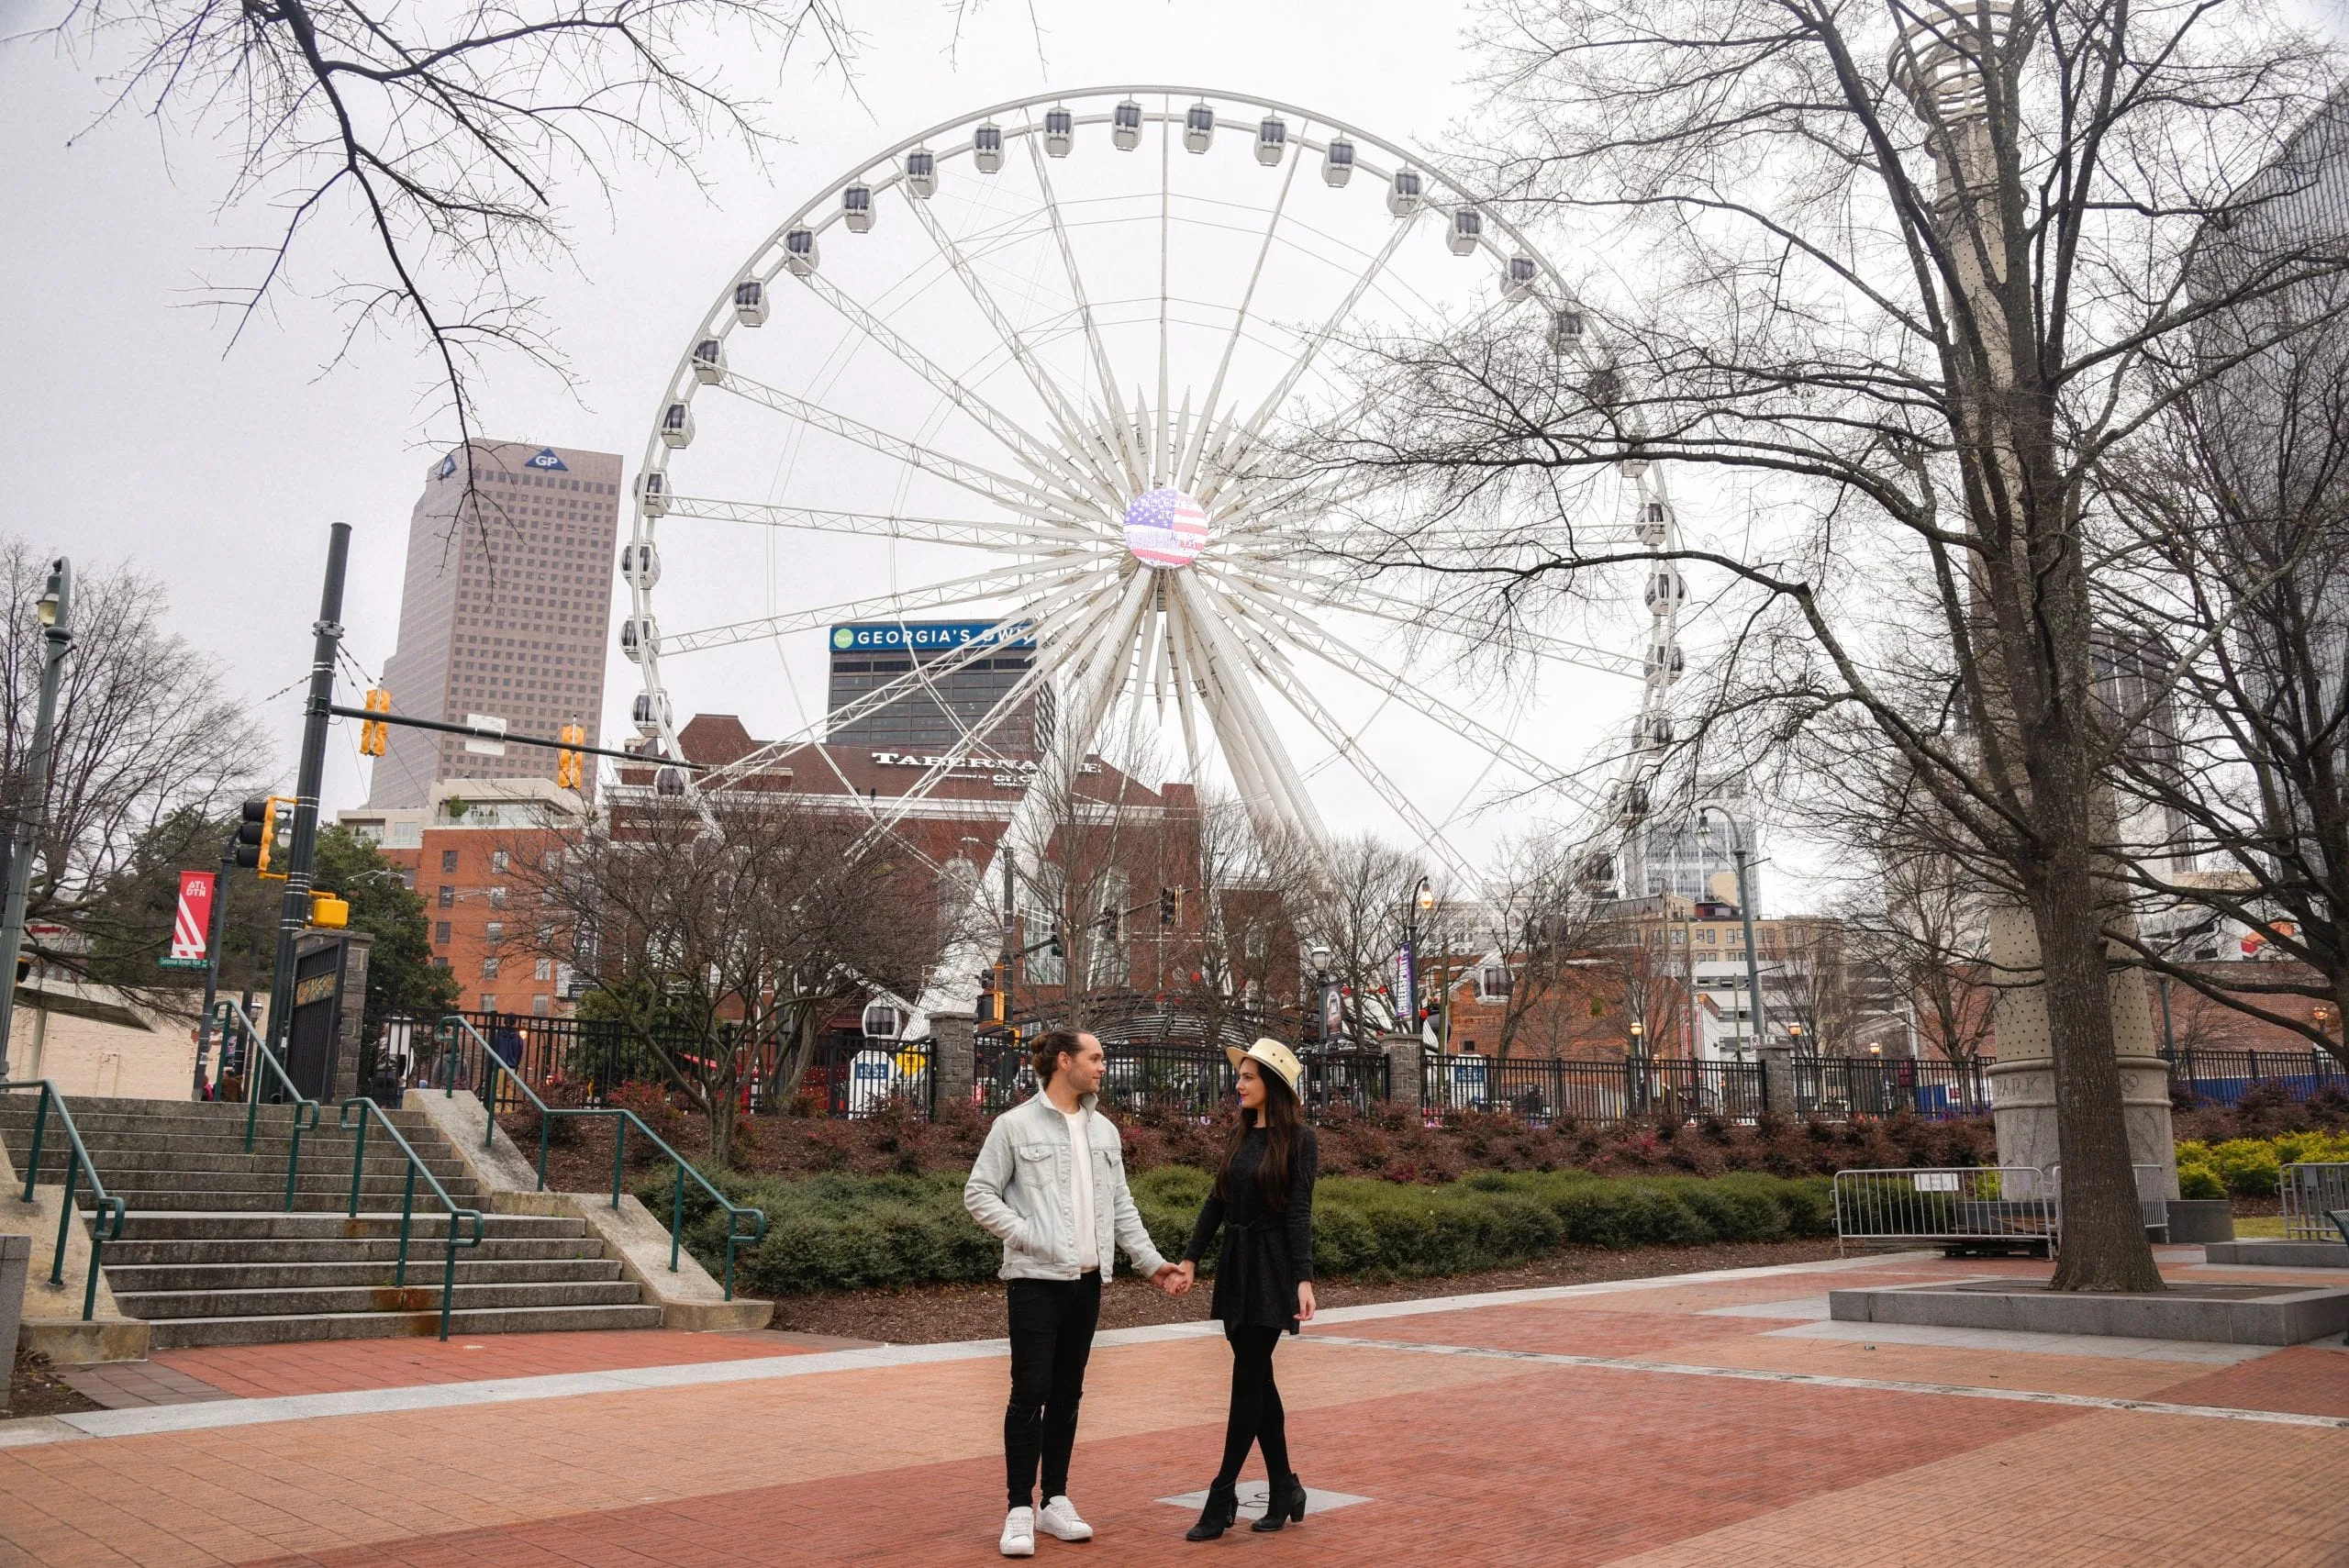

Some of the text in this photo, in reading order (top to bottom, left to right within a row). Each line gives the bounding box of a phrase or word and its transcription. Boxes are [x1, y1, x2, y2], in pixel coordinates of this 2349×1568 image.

[535, 456, 558, 466] GP
[858, 629, 970, 644] GEORGIA'S
[872, 752, 1101, 773] TABERNAE
[186, 888, 206, 896] DTN
[187, 881, 206, 889] ATL
[1397, 960, 1409, 1013] CHEERSPORT
[1997, 1077, 2040, 1097] PARK
